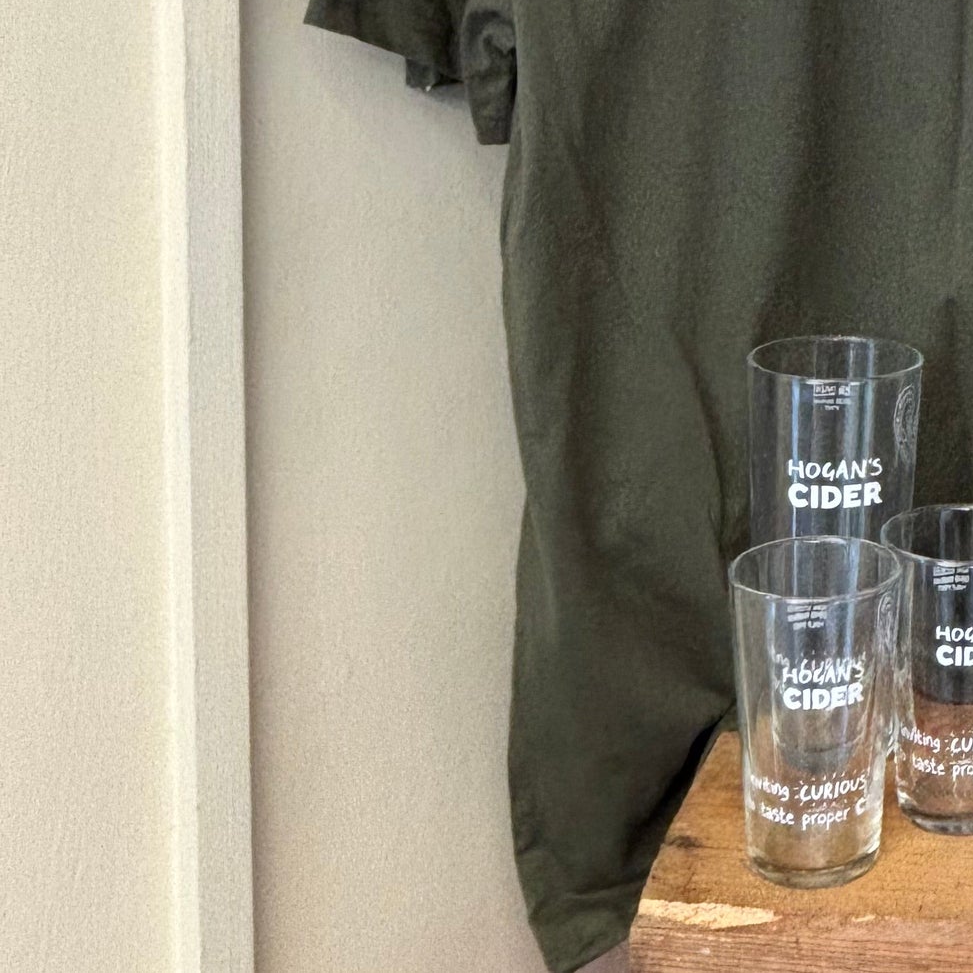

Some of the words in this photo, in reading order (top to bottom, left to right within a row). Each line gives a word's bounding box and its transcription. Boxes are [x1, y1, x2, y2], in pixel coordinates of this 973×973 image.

[788, 457, 883, 482] HOGAN'S
[787, 481, 883, 510] CIDER
[782, 681, 864, 711] CIDER
[912, 753, 946, 777] taste
[799, 773, 867, 803] CURIOUS
[760, 801, 795, 826] taste
[801, 806, 851, 832] proper
